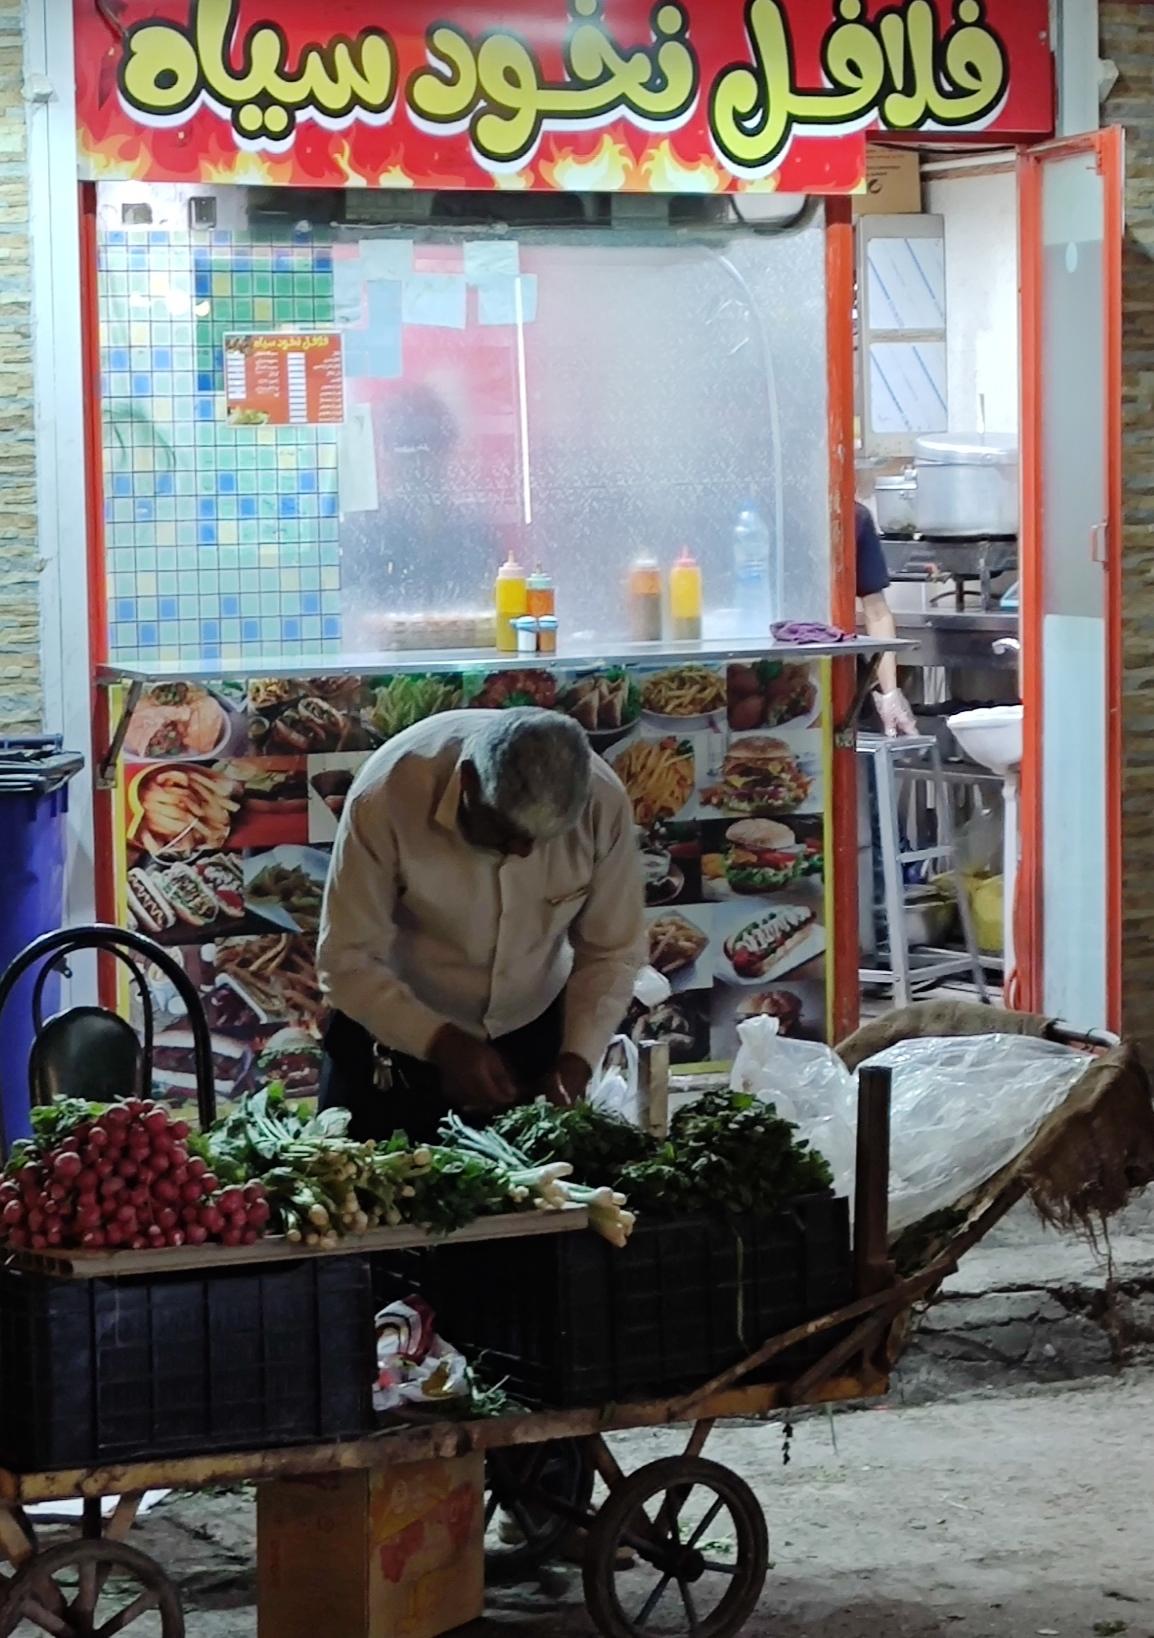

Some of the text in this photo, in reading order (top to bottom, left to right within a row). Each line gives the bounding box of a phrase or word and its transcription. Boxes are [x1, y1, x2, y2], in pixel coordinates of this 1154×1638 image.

[120, 0, 1007, 166] فلافل نخود سیاه
